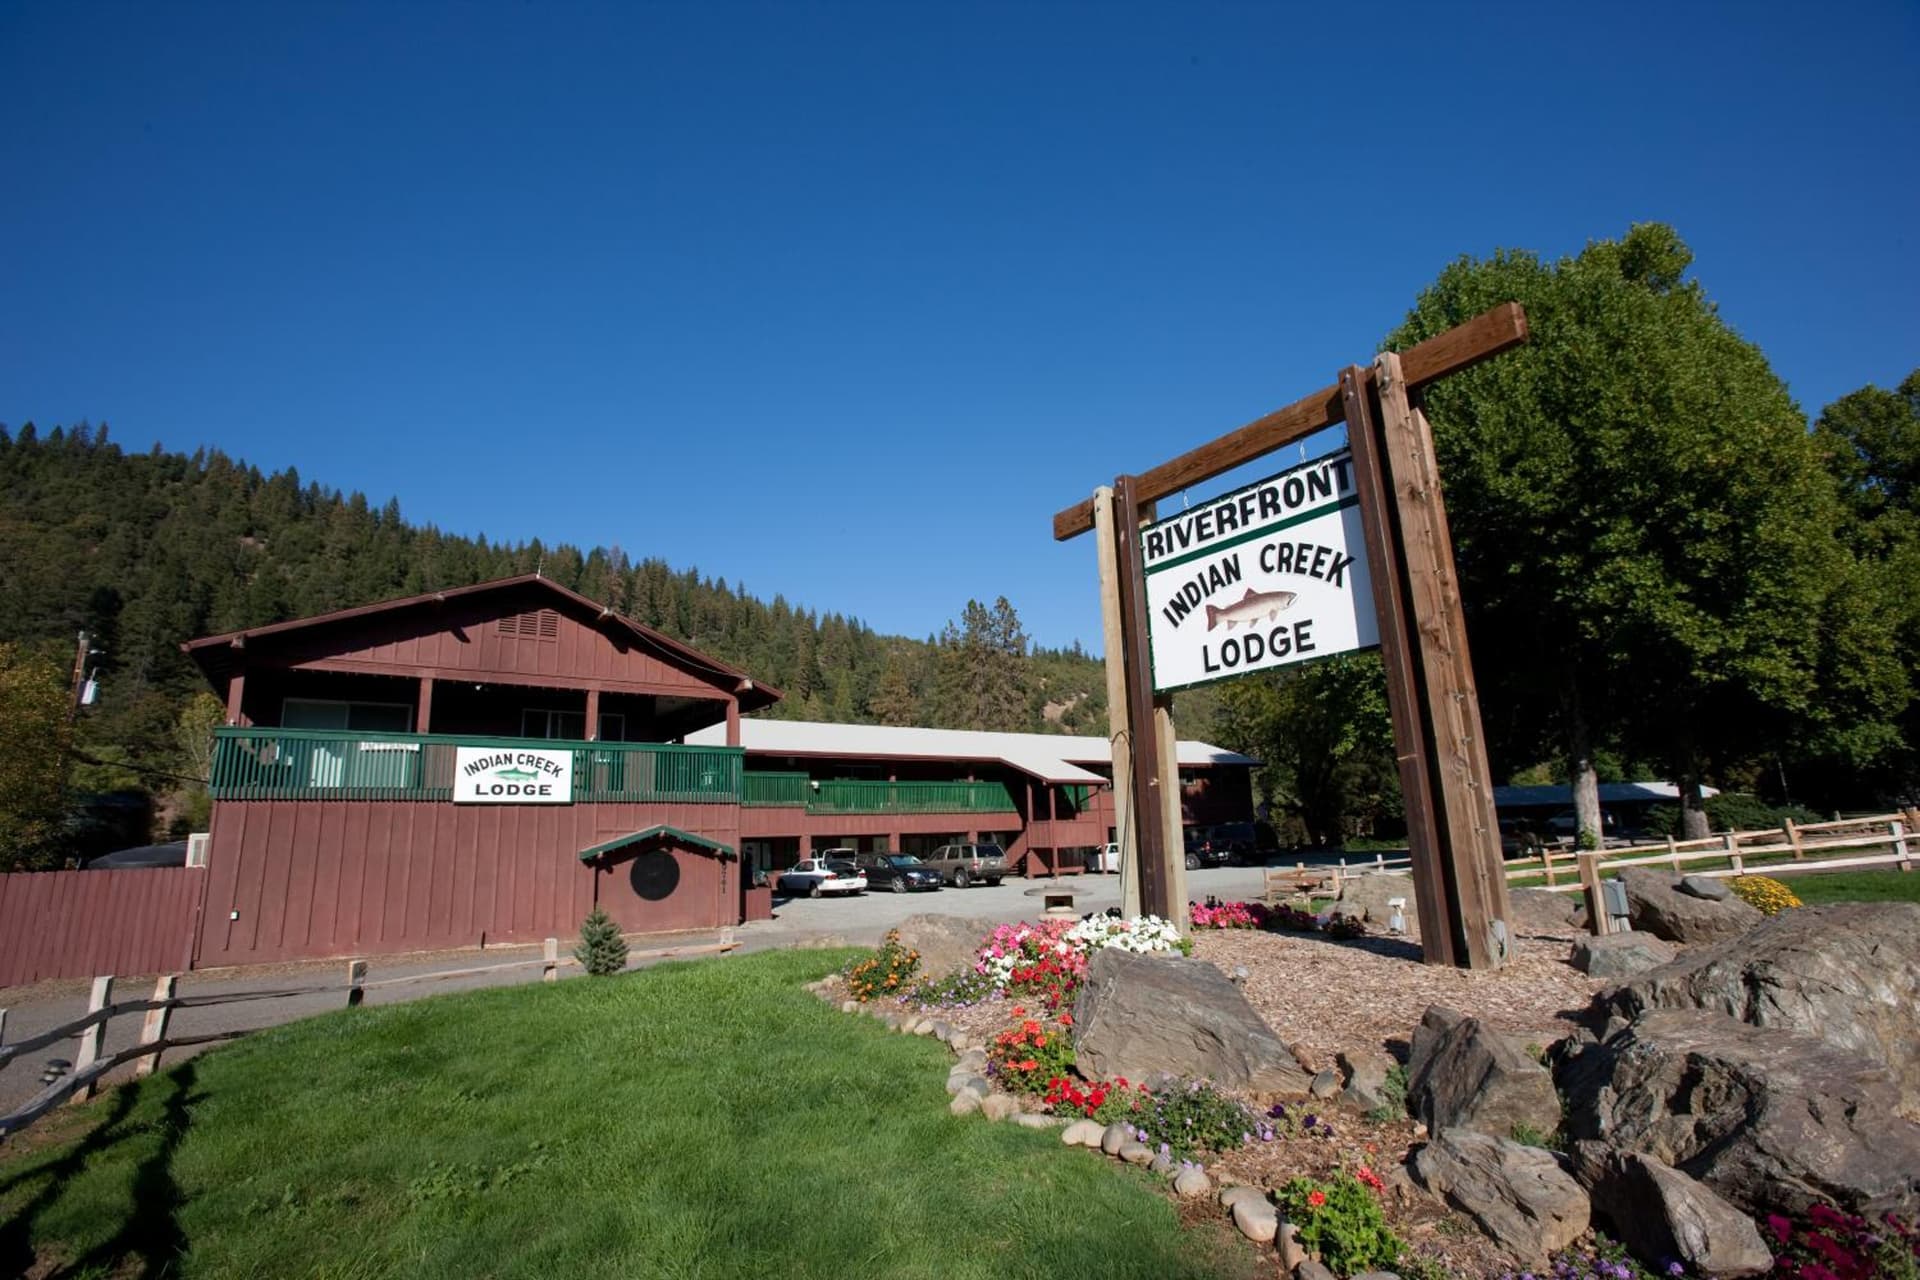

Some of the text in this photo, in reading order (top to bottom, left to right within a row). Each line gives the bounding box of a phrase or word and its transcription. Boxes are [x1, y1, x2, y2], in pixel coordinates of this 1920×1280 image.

[1146, 458, 1354, 560] RIVERFRONT
[1162, 542, 1356, 629] INDIAN CREEK
[1202, 619, 1316, 673] LODGE
[464, 753, 564, 778] INDIAN CREEK
[475, 784, 552, 796] LODGE
